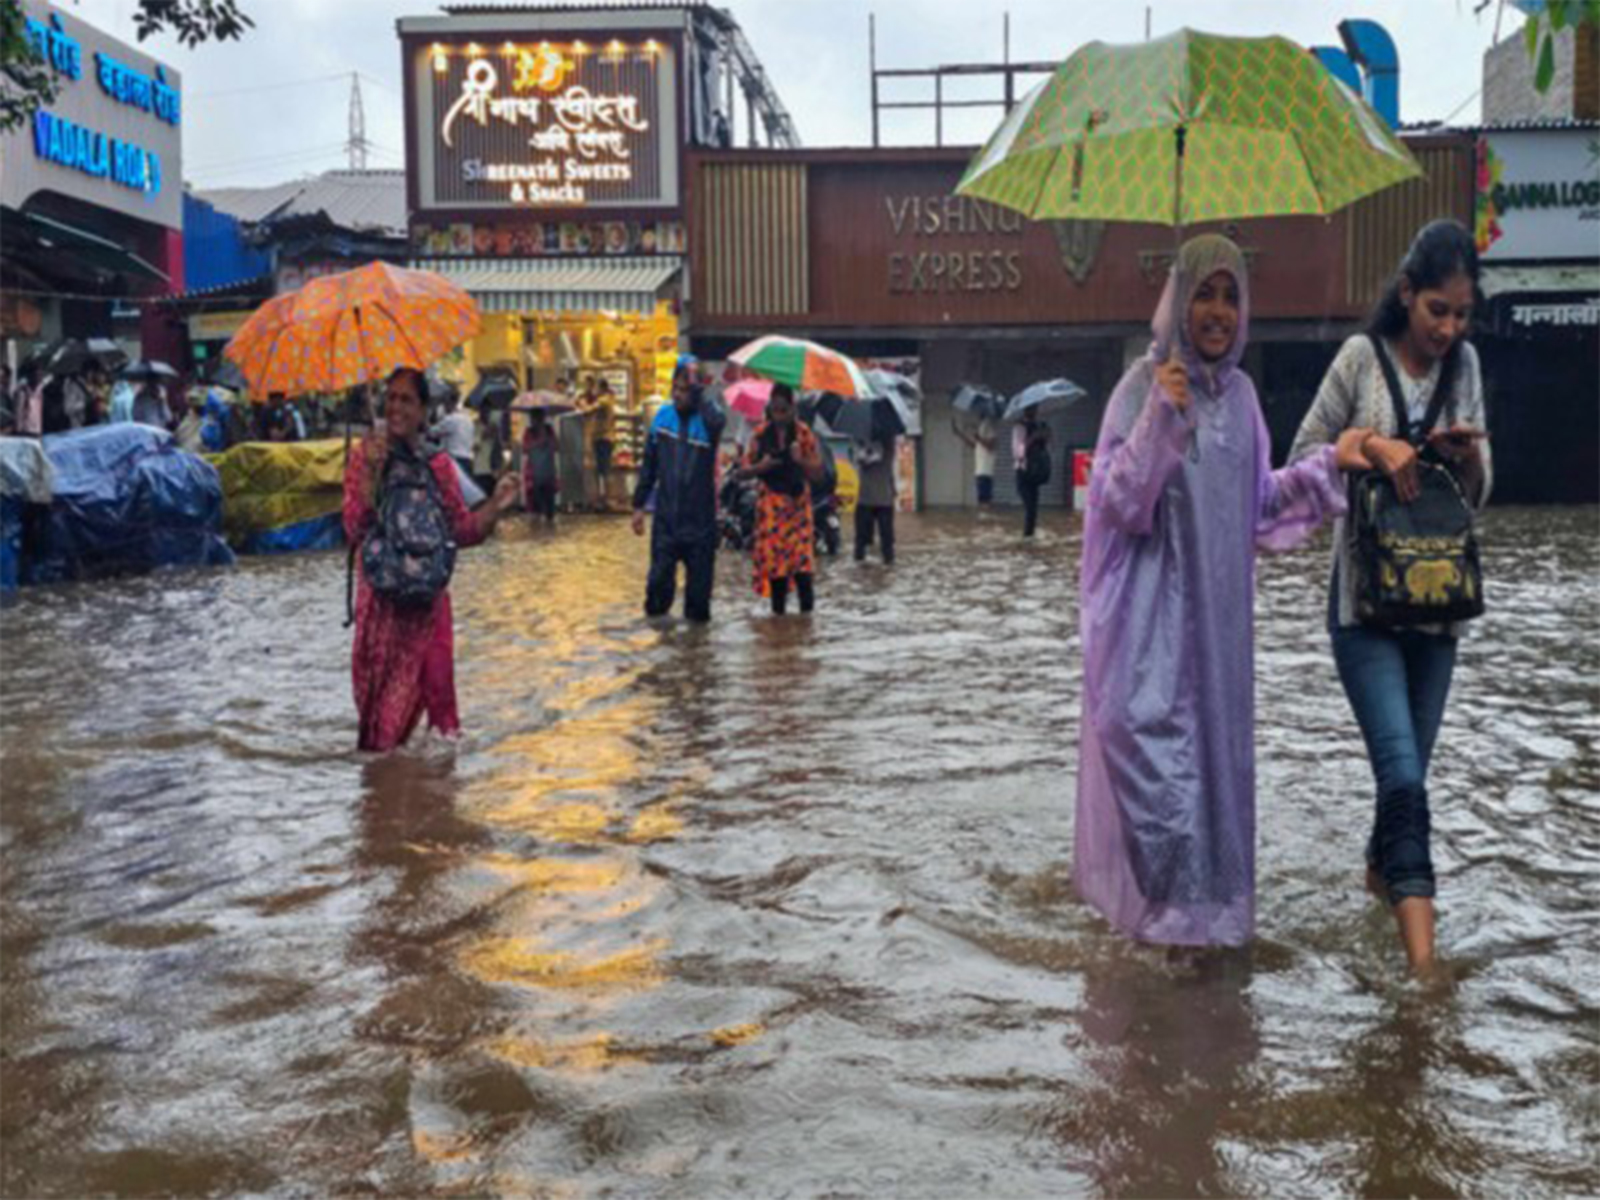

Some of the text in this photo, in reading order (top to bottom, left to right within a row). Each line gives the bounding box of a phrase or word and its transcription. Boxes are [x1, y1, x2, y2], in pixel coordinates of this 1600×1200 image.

[35, 108, 107, 177] VADALA
[885, 196, 1022, 235] VISHNU
[886, 250, 1022, 293] EXPRESS
